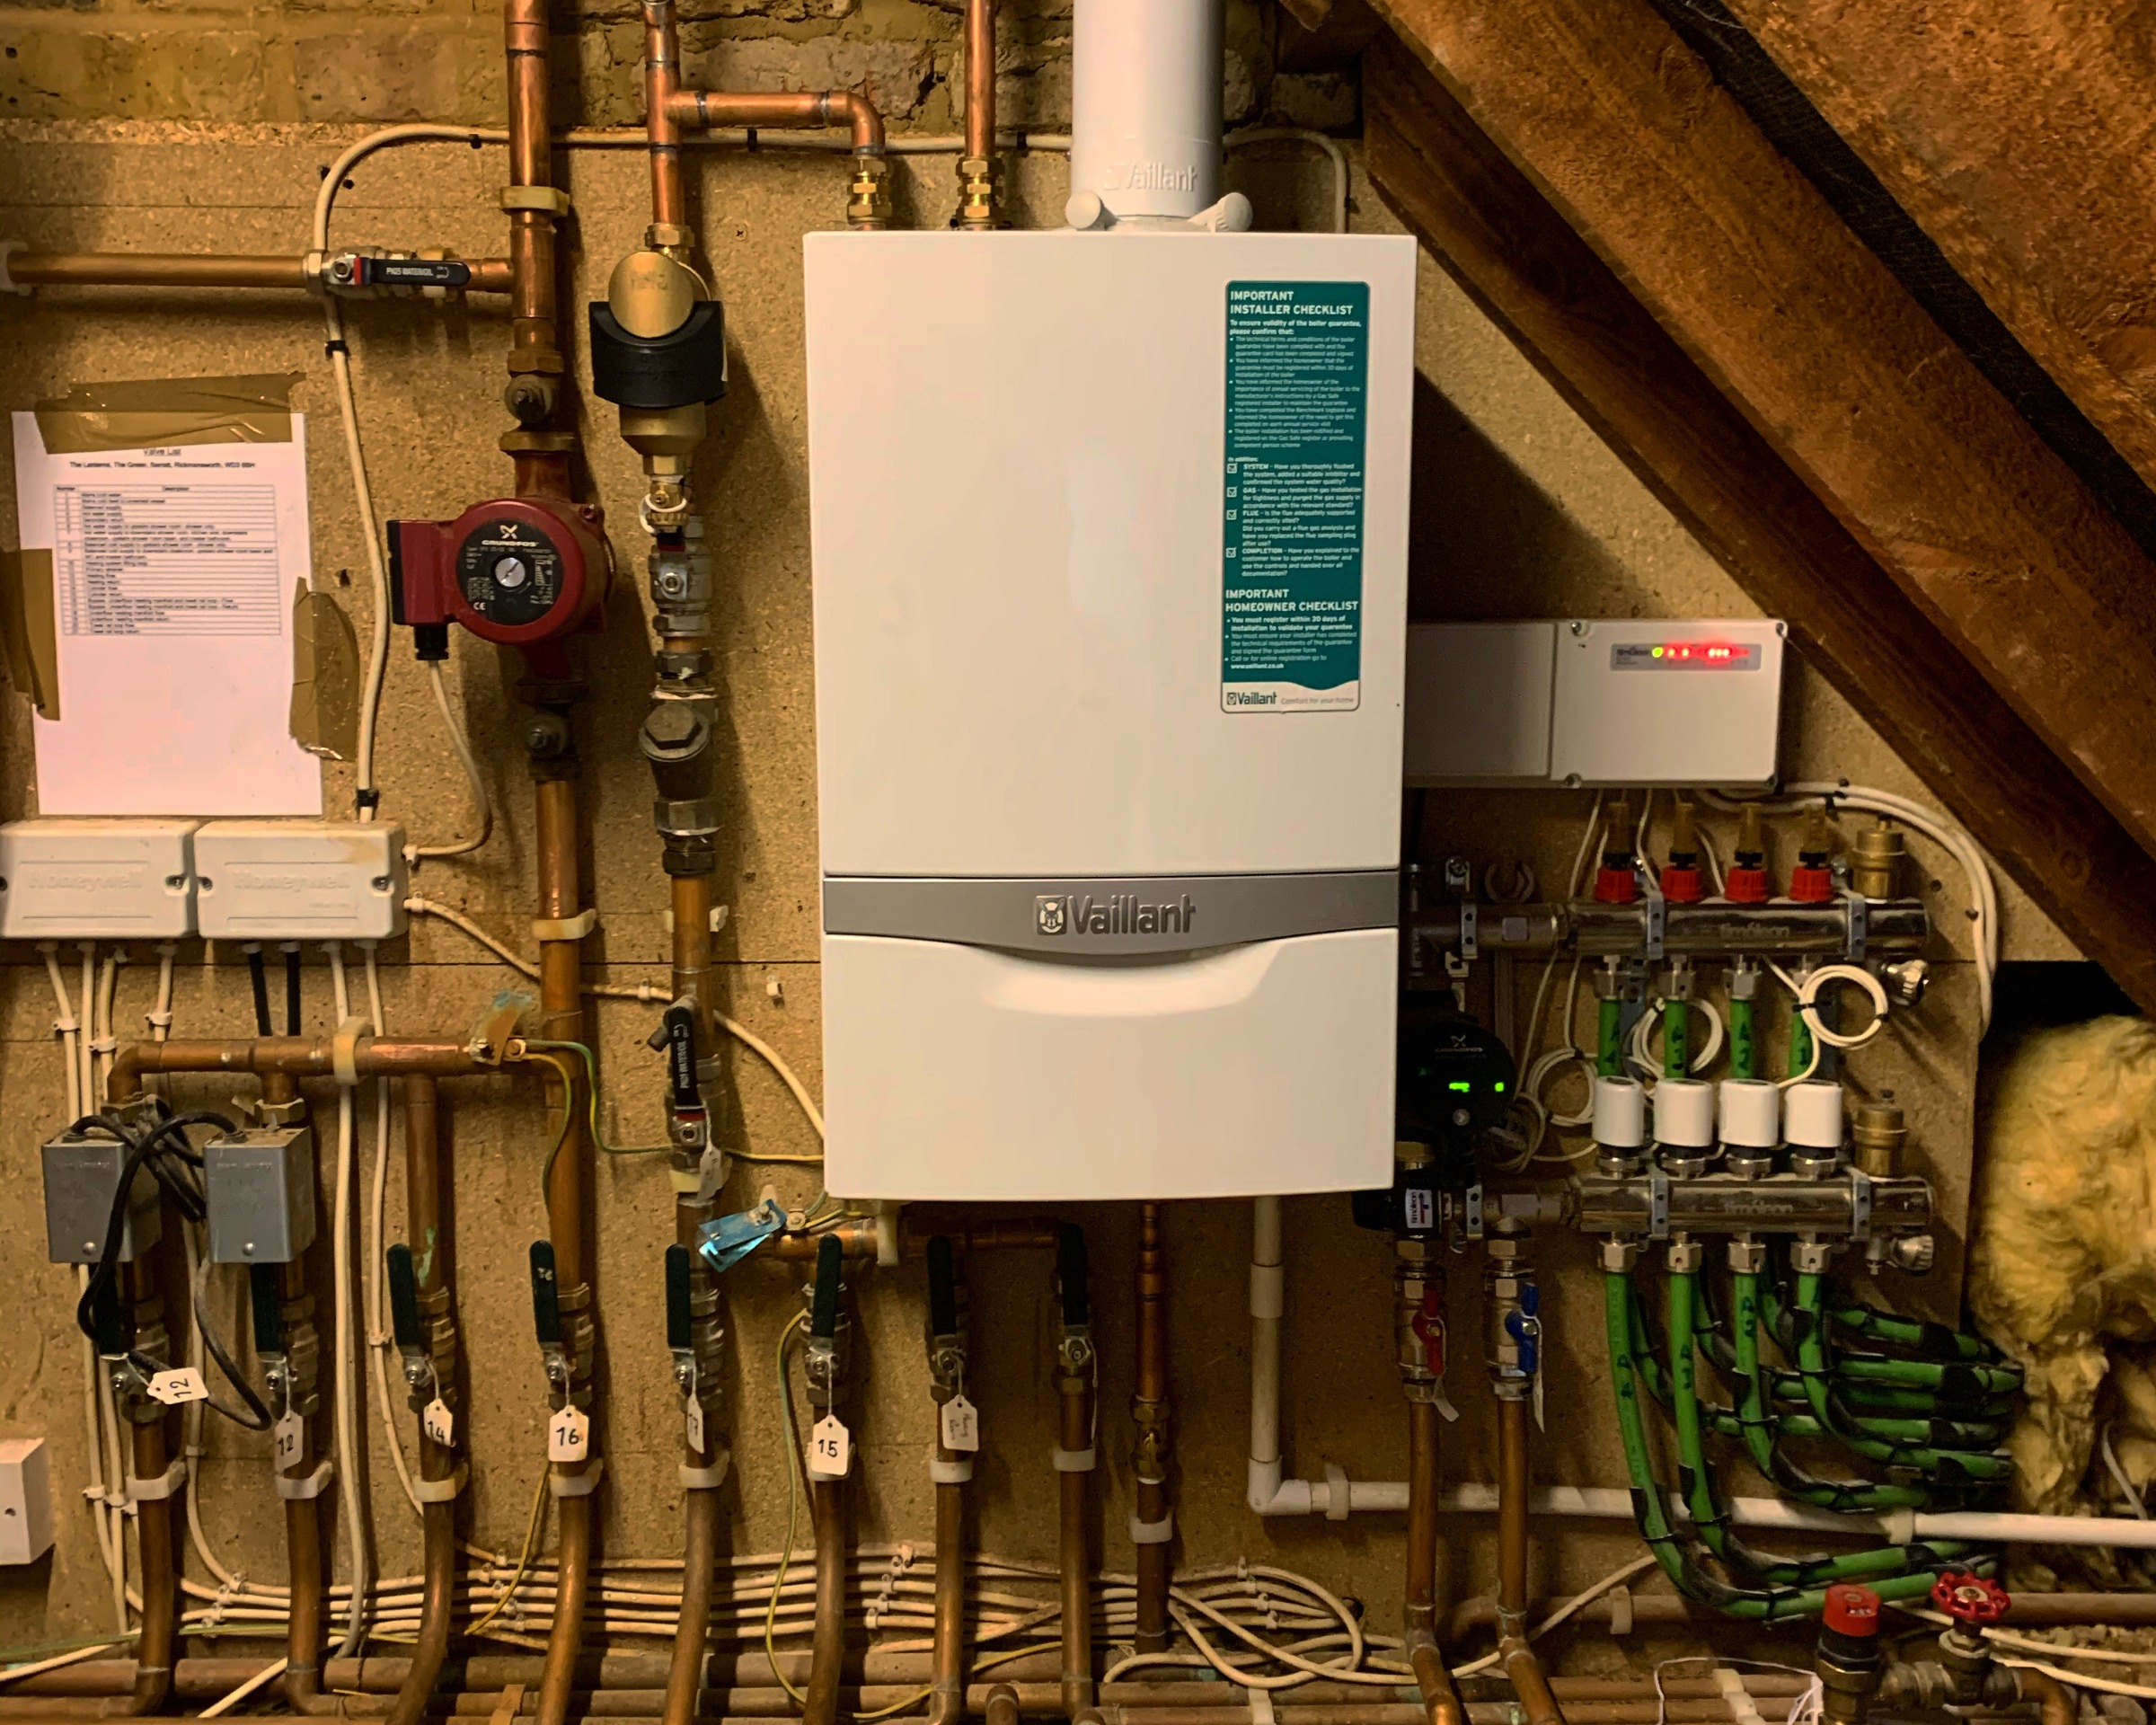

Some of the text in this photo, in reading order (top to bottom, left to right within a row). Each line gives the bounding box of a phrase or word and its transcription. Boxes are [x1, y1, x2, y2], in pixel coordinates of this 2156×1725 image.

[1231, 291, 1294, 300] IMPORTANT
[1231, 305, 1353, 314] INSTALLER CHECKLIST
[1226, 589, 1289, 598] IMPORTANT
[1225, 601, 1358, 611] HOMEOWNER CHECKLIST
[1238, 692, 1277, 704] Vaillant
[1067, 894, 1197, 934] Vaillant
[170, 1377, 193, 1398] 12
[427, 1420, 446, 1441] 14
[555, 1427, 579, 1446] 16
[817, 1439, 838, 1458] 15
